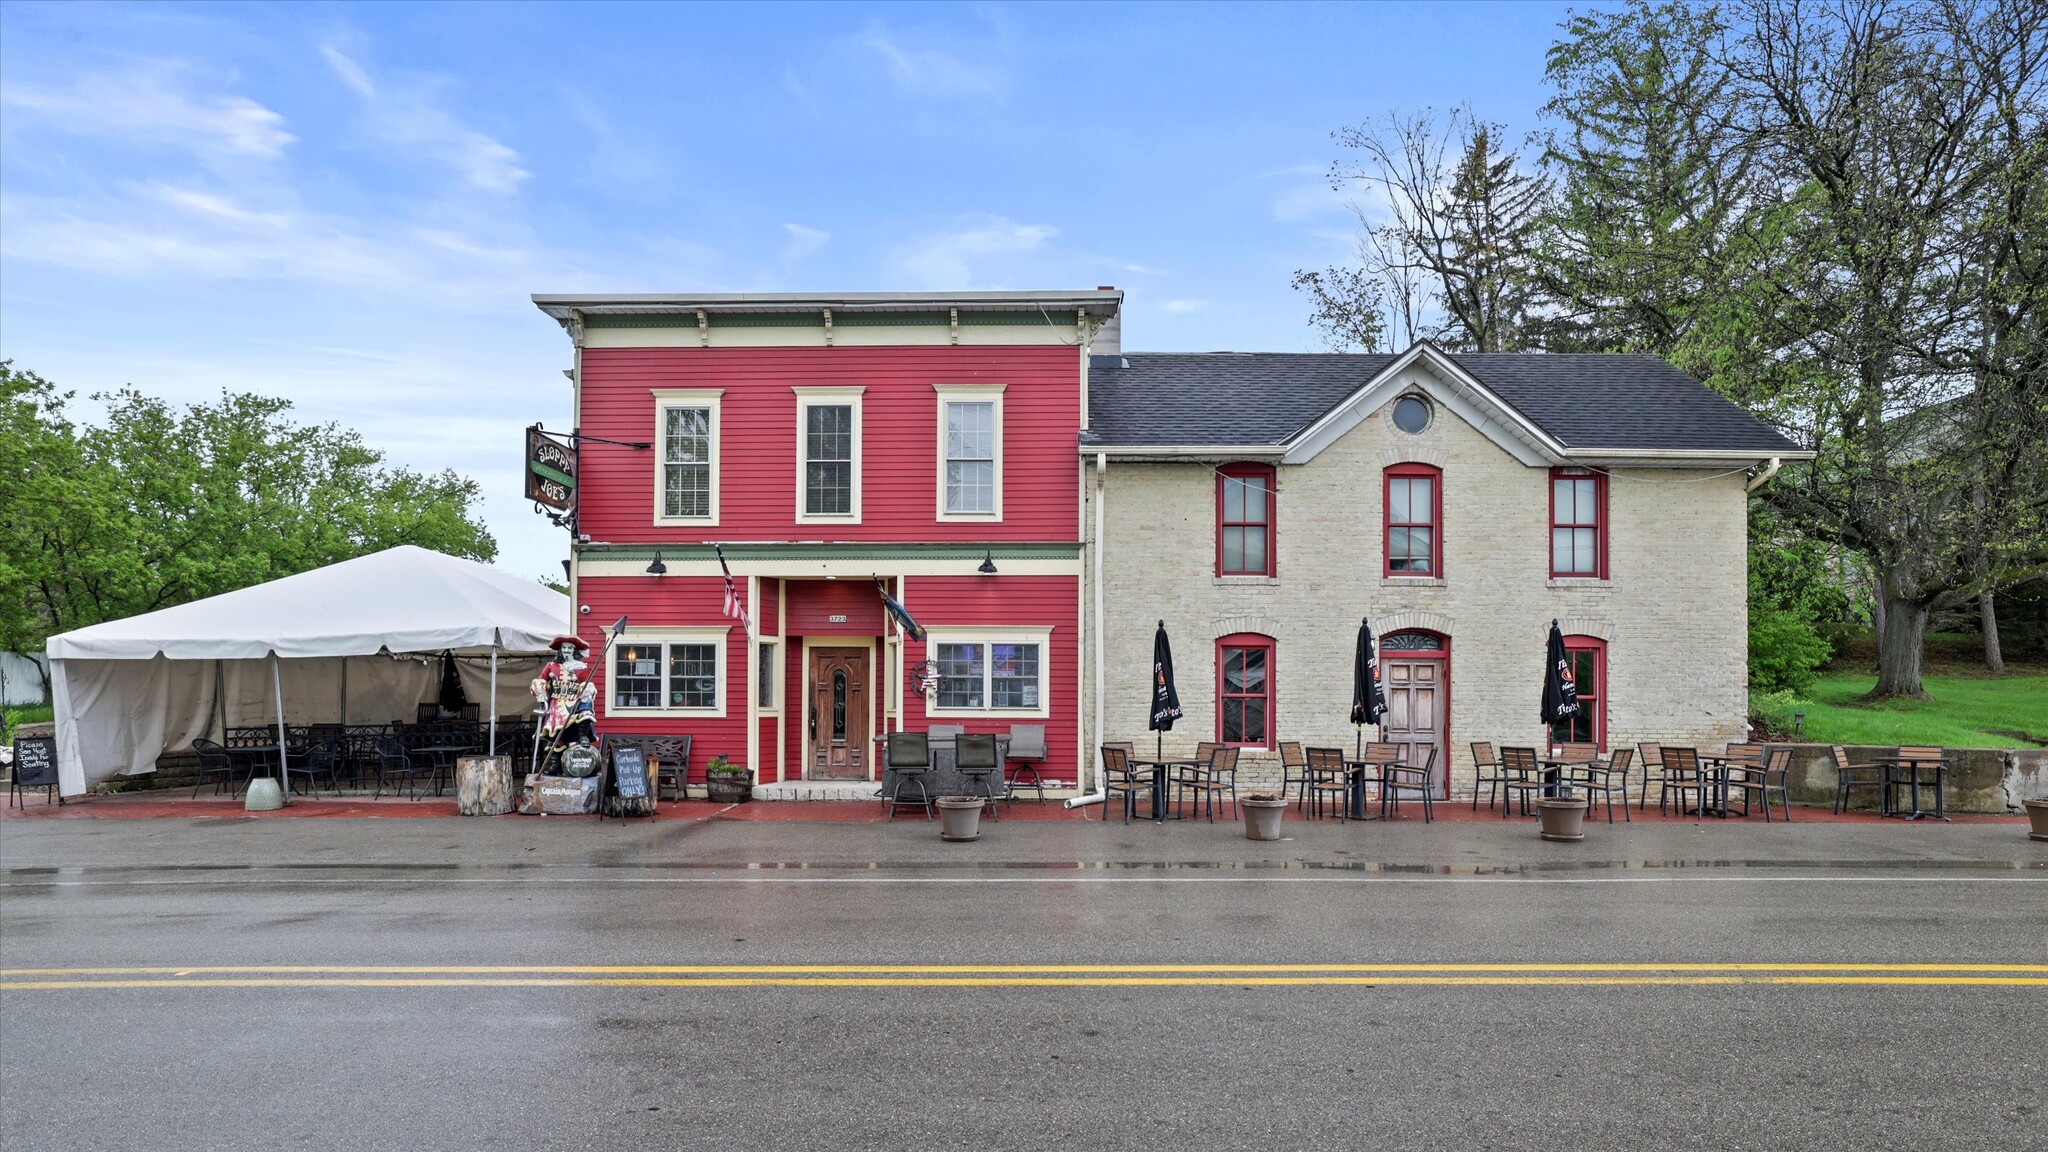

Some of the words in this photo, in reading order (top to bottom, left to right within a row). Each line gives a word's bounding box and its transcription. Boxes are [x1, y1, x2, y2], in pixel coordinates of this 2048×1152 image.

[538, 446, 570, 473] SLOPPY
[540, 479, 566, 500] JOE'S
[22, 760, 50, 768] Seating
[616, 753, 640, 764] Curbside
[619, 777, 643, 786] Parking
